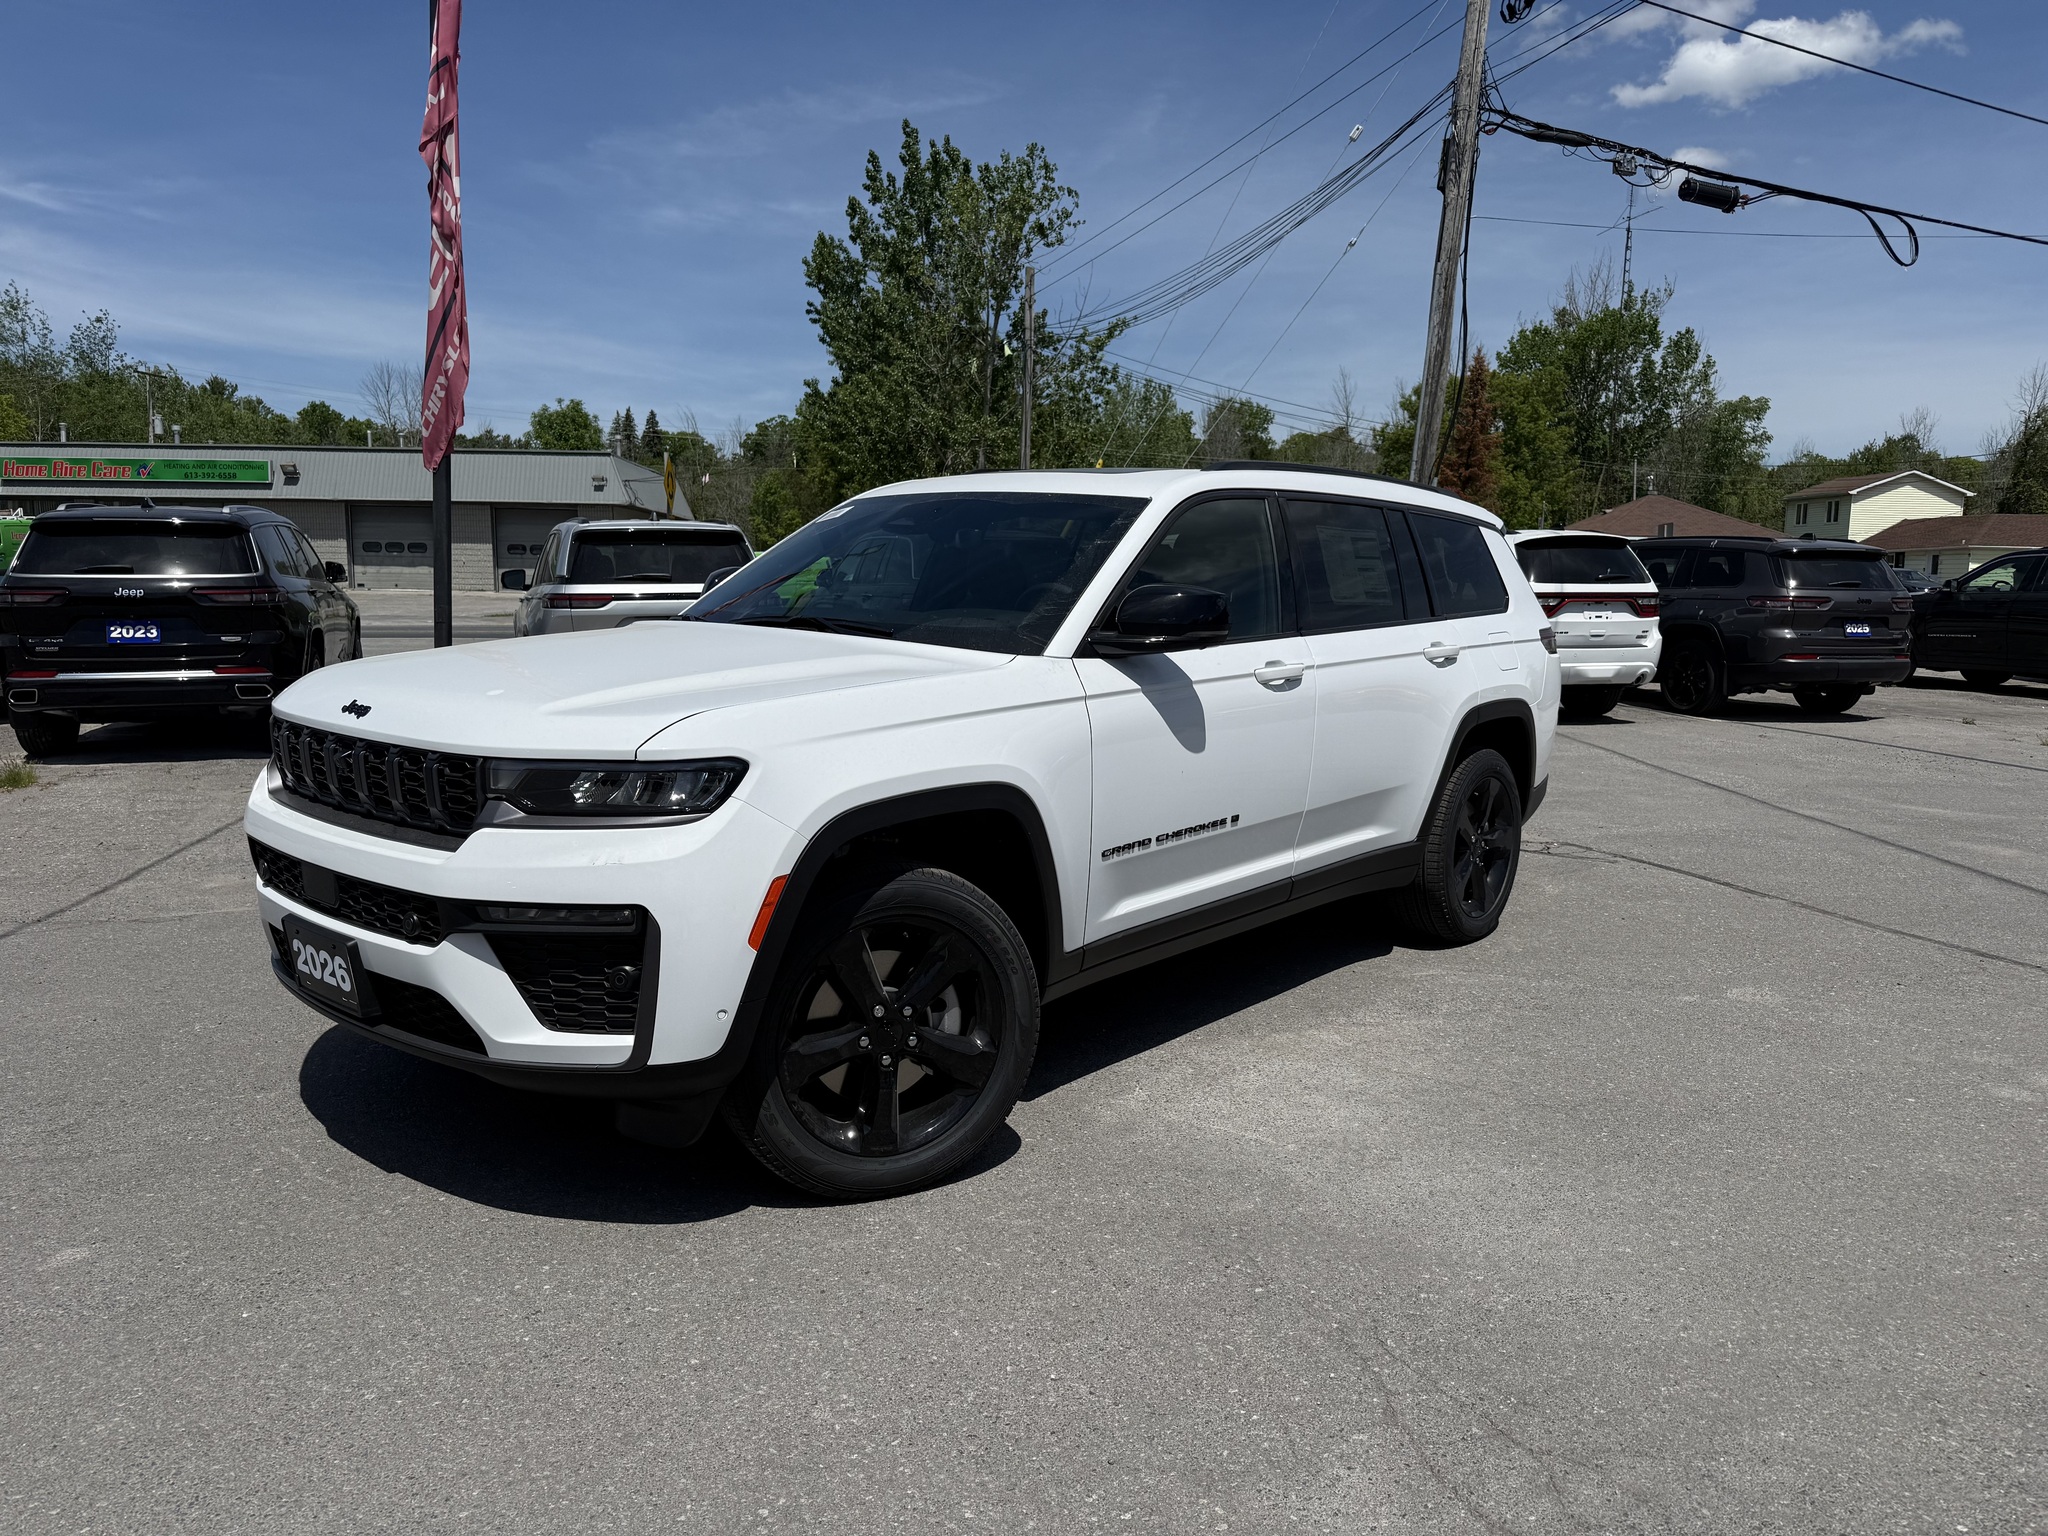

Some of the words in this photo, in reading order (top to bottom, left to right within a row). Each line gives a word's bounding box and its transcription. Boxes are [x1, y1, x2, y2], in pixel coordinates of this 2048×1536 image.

[422, 325, 461, 438] CHRYSL
[3, 460, 47, 477] Home
[52, 460, 87, 478] Aire
[91, 461, 131, 478] Care
[114, 587, 144, 598] Jeep
[109, 625, 158, 638] 2023
[1845, 623, 1870, 633] 2025
[1101, 837, 1153, 859] GRAND
[1155, 817, 1228, 843] CHEROKEE
[292, 938, 352, 992] 2026
